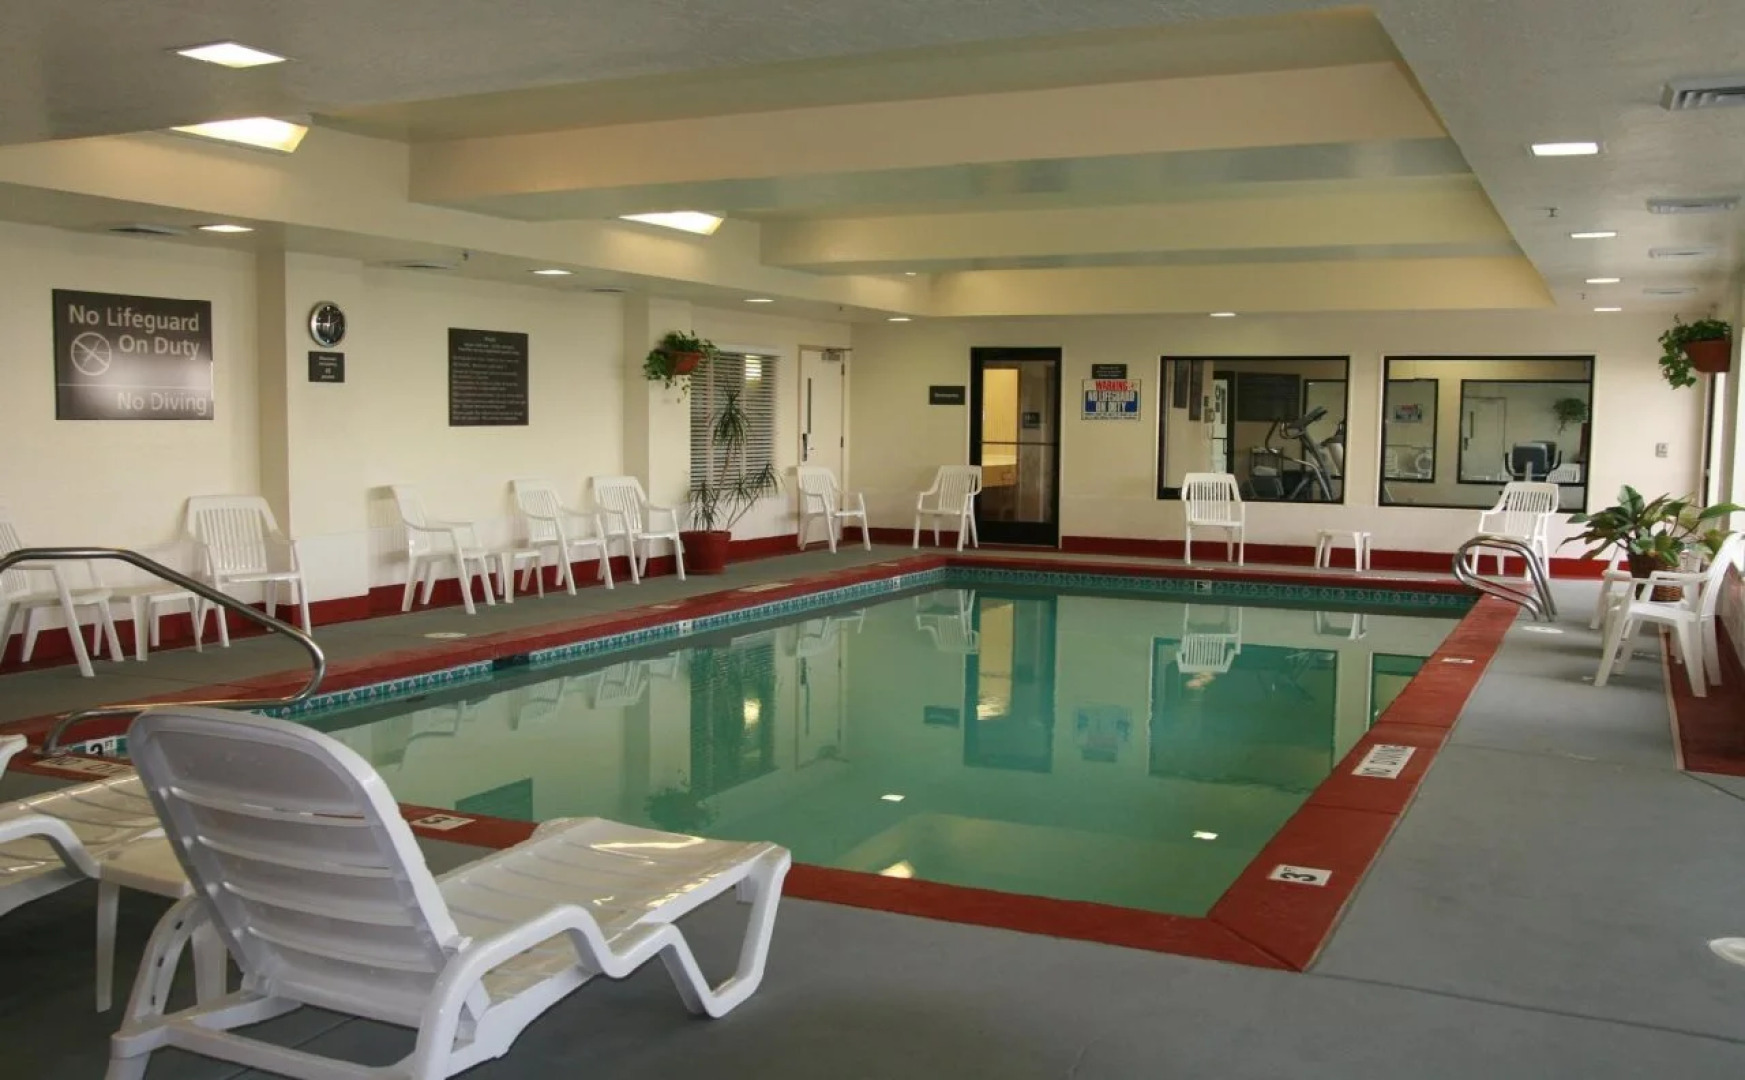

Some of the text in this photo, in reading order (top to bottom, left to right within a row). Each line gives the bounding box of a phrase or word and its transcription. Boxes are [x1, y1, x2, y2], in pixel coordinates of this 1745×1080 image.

[68, 304, 200, 334] No Lifeguard
[119, 334, 200, 361] On Duty
[117, 392, 207, 416] No Diving
[1280, 872, 1318, 882] 3
